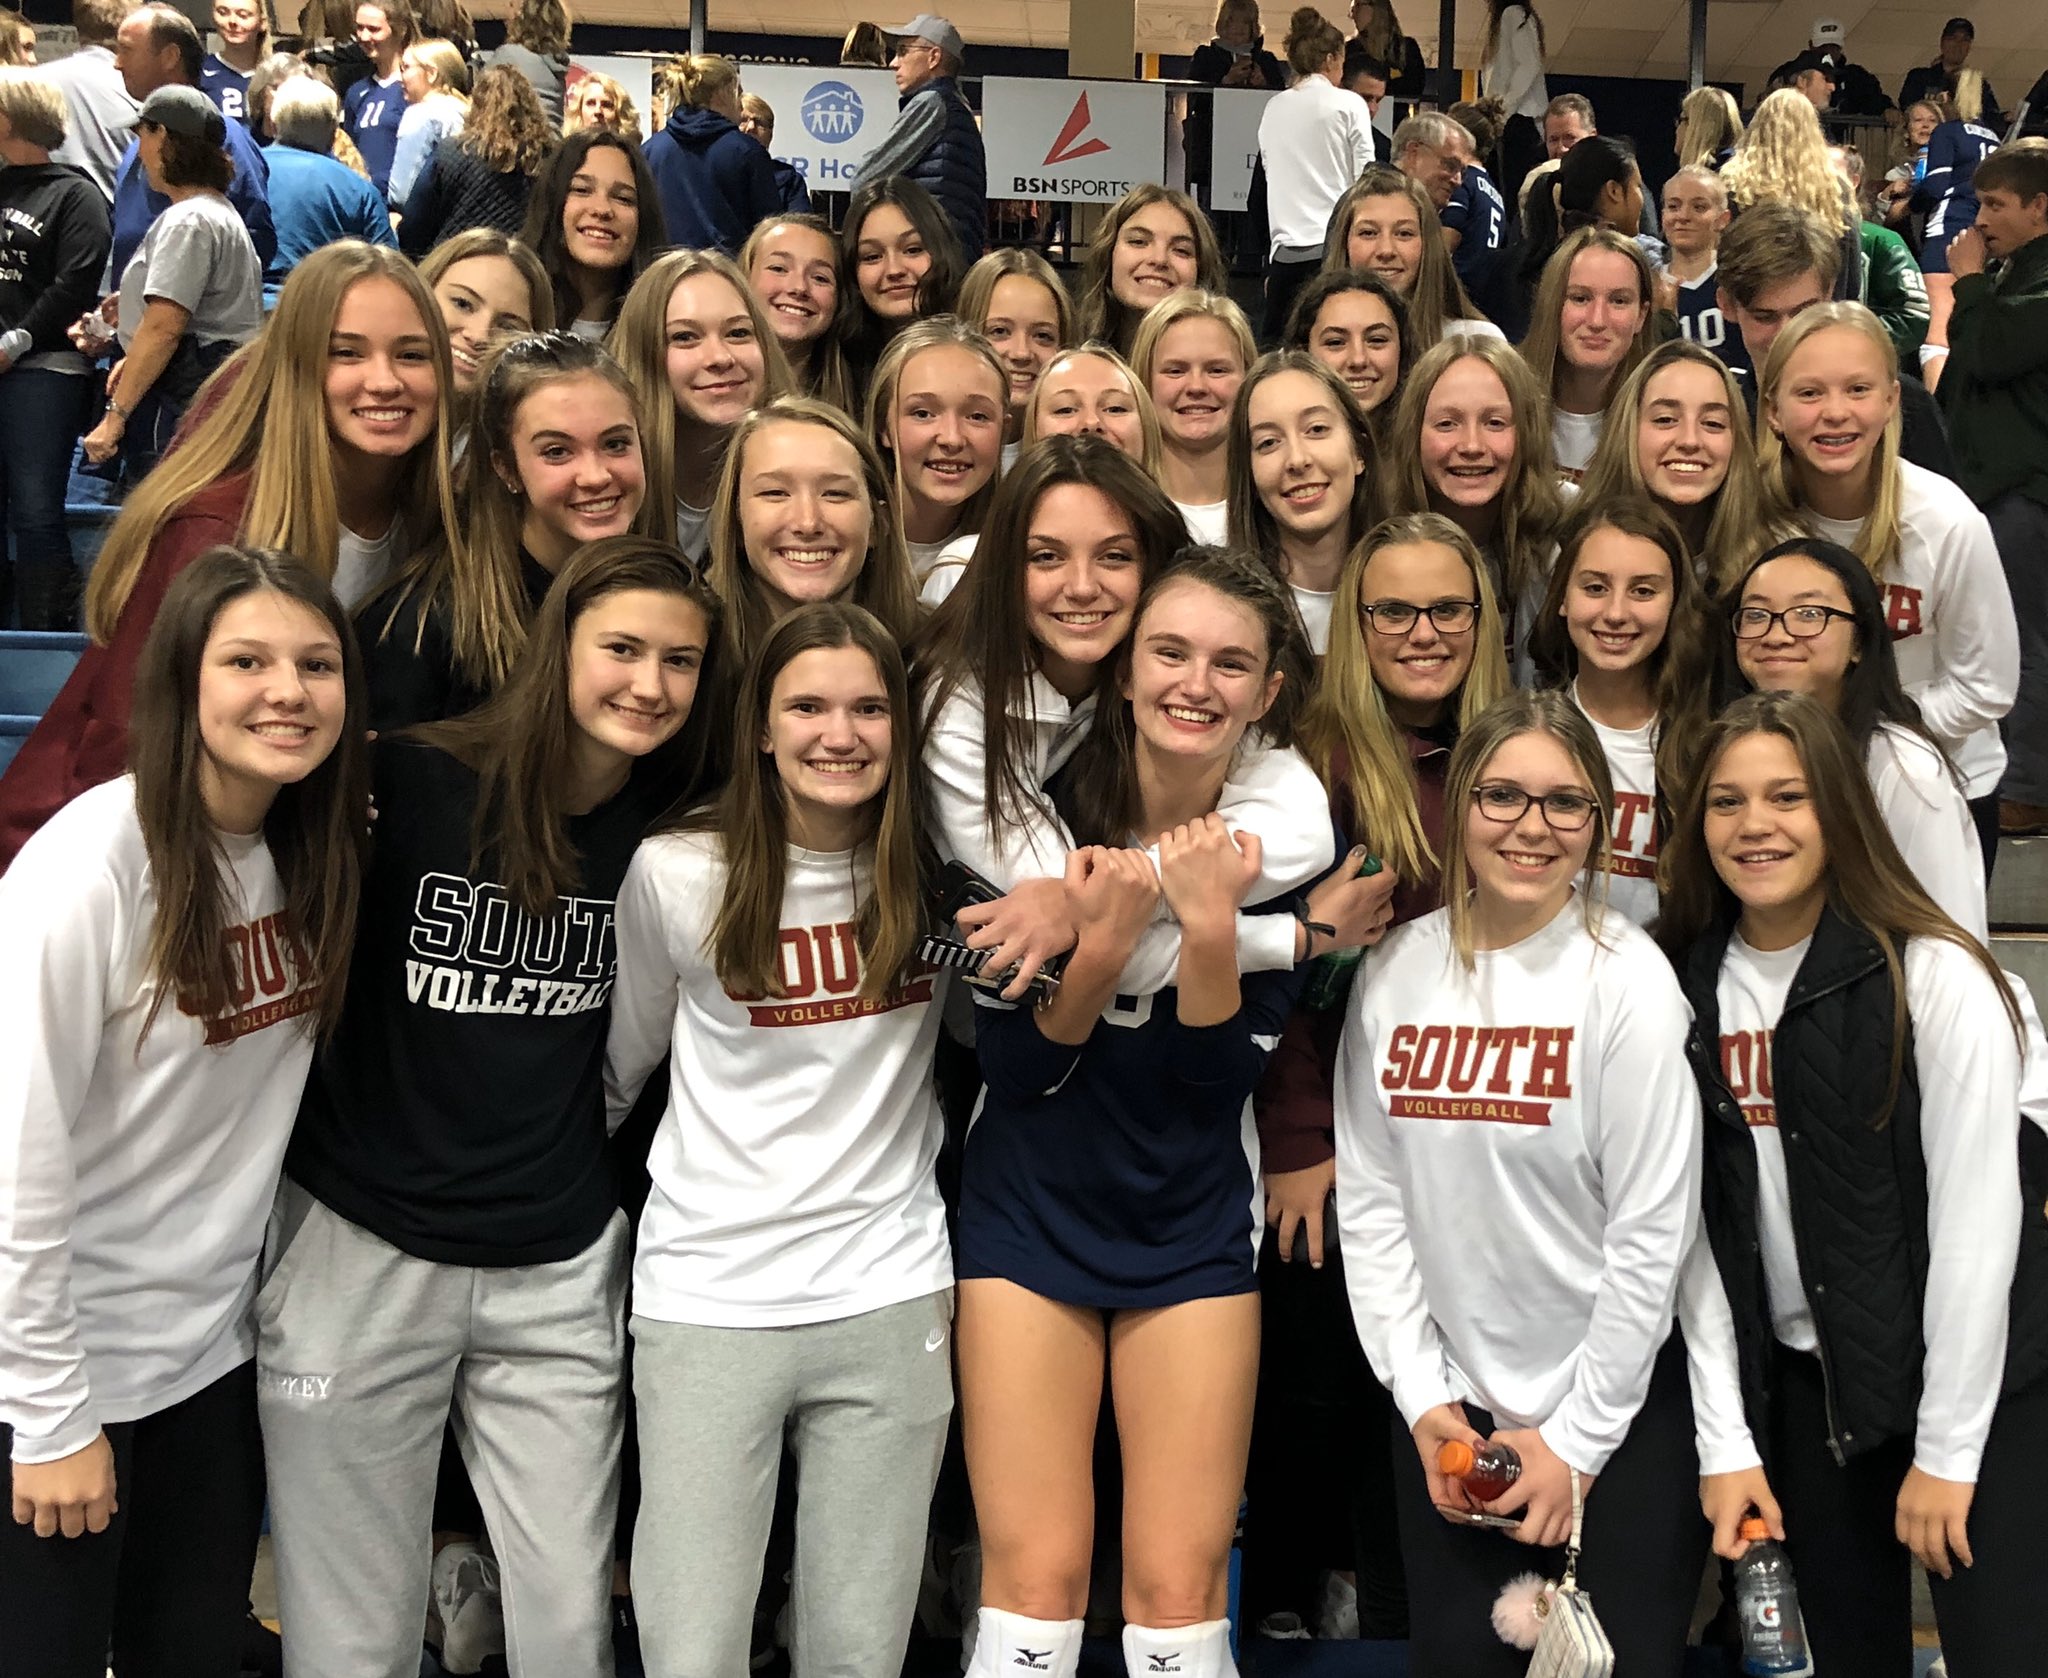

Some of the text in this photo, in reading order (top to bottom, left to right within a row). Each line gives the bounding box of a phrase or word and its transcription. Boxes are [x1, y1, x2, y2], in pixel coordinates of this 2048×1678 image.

[222, 88, 243, 118] 2
[359, 100, 386, 128] 11
[1013, 177, 1130, 197] BSN SPORTS
[1487, 206, 1501, 248] 5
[1679, 307, 1726, 348] 10
[409, 872, 617, 979] SOUT
[405, 959, 615, 1016] VOLLEYBAL
[231, 992, 314, 1032] VOLLEYA
[1381, 1024, 1575, 1099] SOUTH
[1404, 1100, 1524, 1120] VOLLEYBALL
[1757, 1598, 1780, 1628] G
